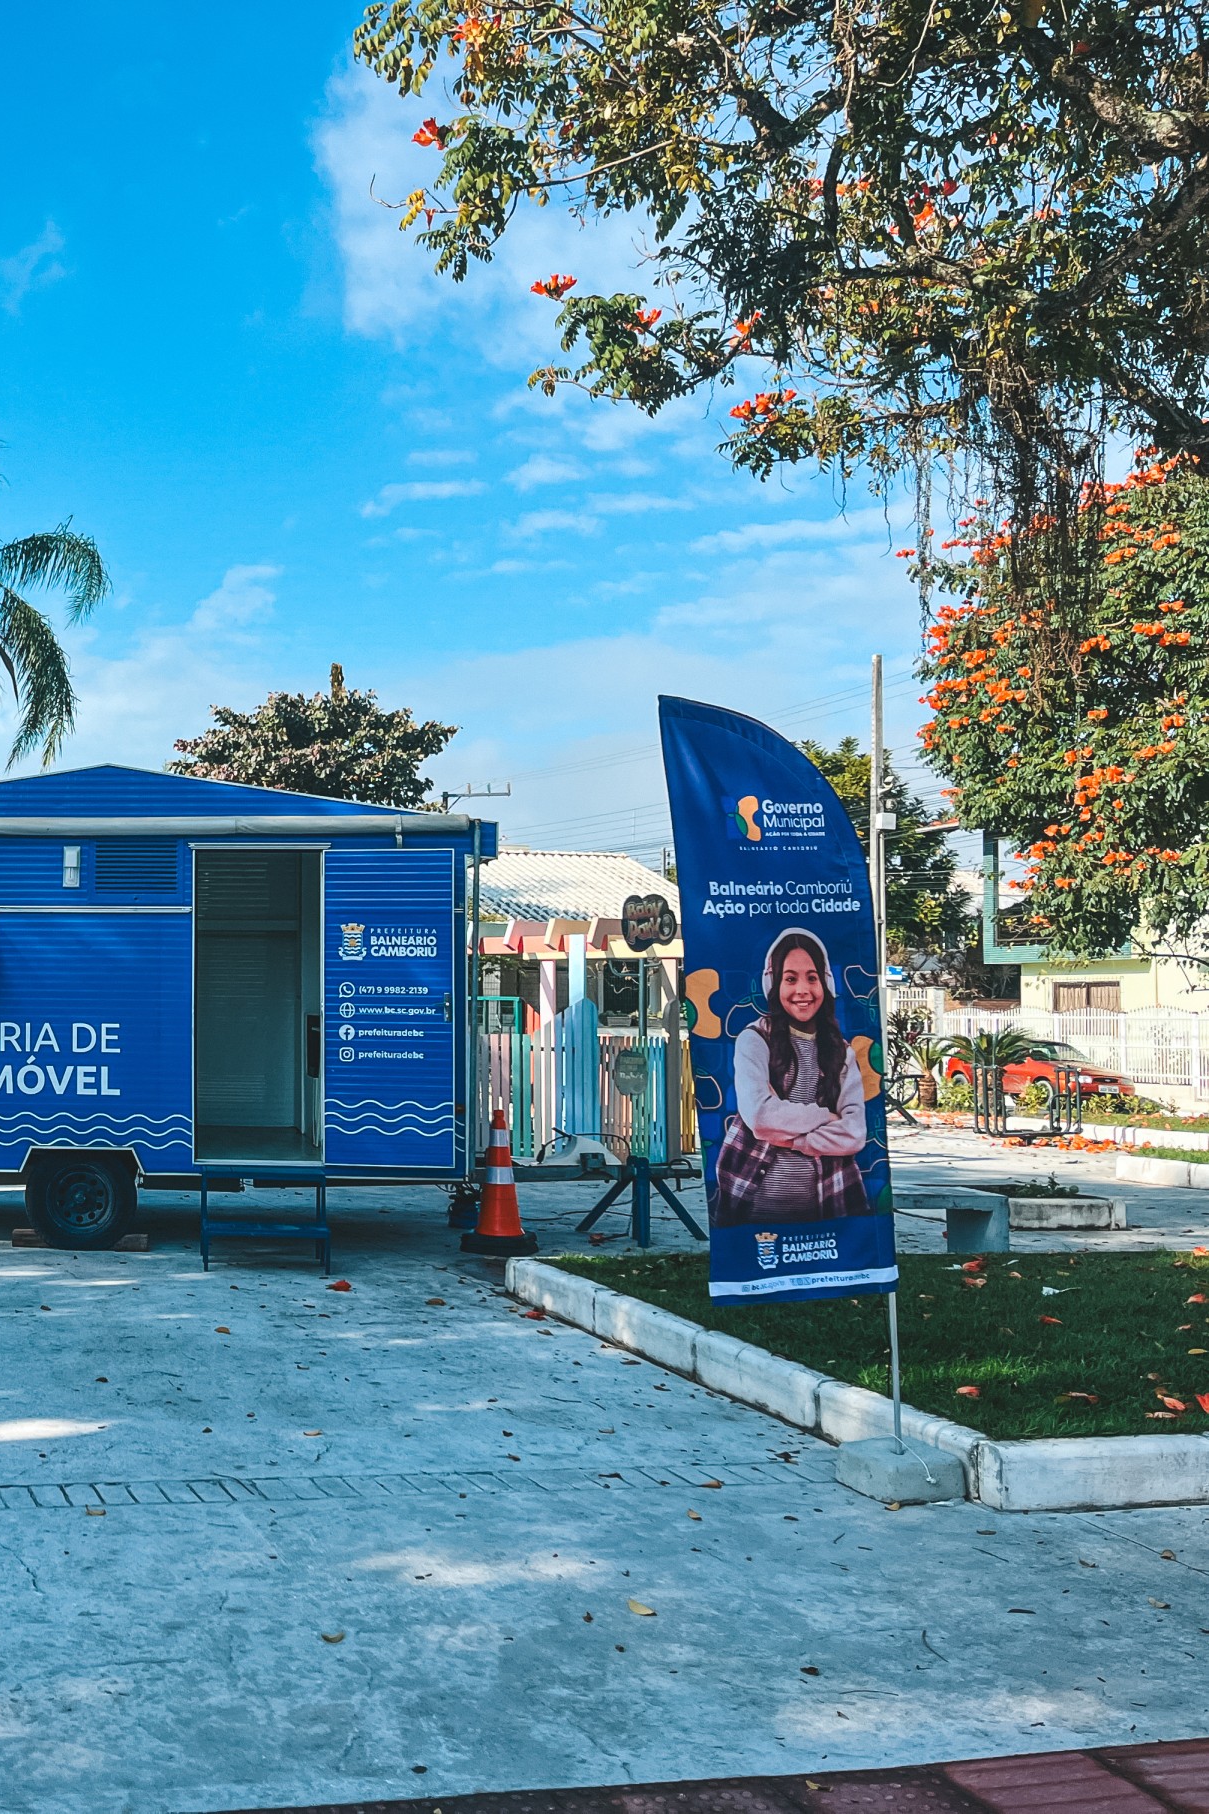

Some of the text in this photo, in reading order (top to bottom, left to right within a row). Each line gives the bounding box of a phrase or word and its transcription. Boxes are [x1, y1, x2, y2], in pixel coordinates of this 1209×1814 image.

[761, 799, 824, 814] Governo
[762, 814, 826, 831] Municipal
[709, 879, 852, 896] Balneário Camboriú
[702, 897, 861, 919] Ação por toda Cidade
[370, 935, 437, 946] BALNEÁRIO
[370, 945, 437, 957] CAMBORIÚ
[358, 986, 375, 994] (47)
[359, 1006, 436, 1015] www.bc.sc.gov.br
[72, 1023, 120, 1053] DE
[358, 1029, 424, 1037] prefeituradebc
[358, 1051, 424, 1060] prefeituradebc
